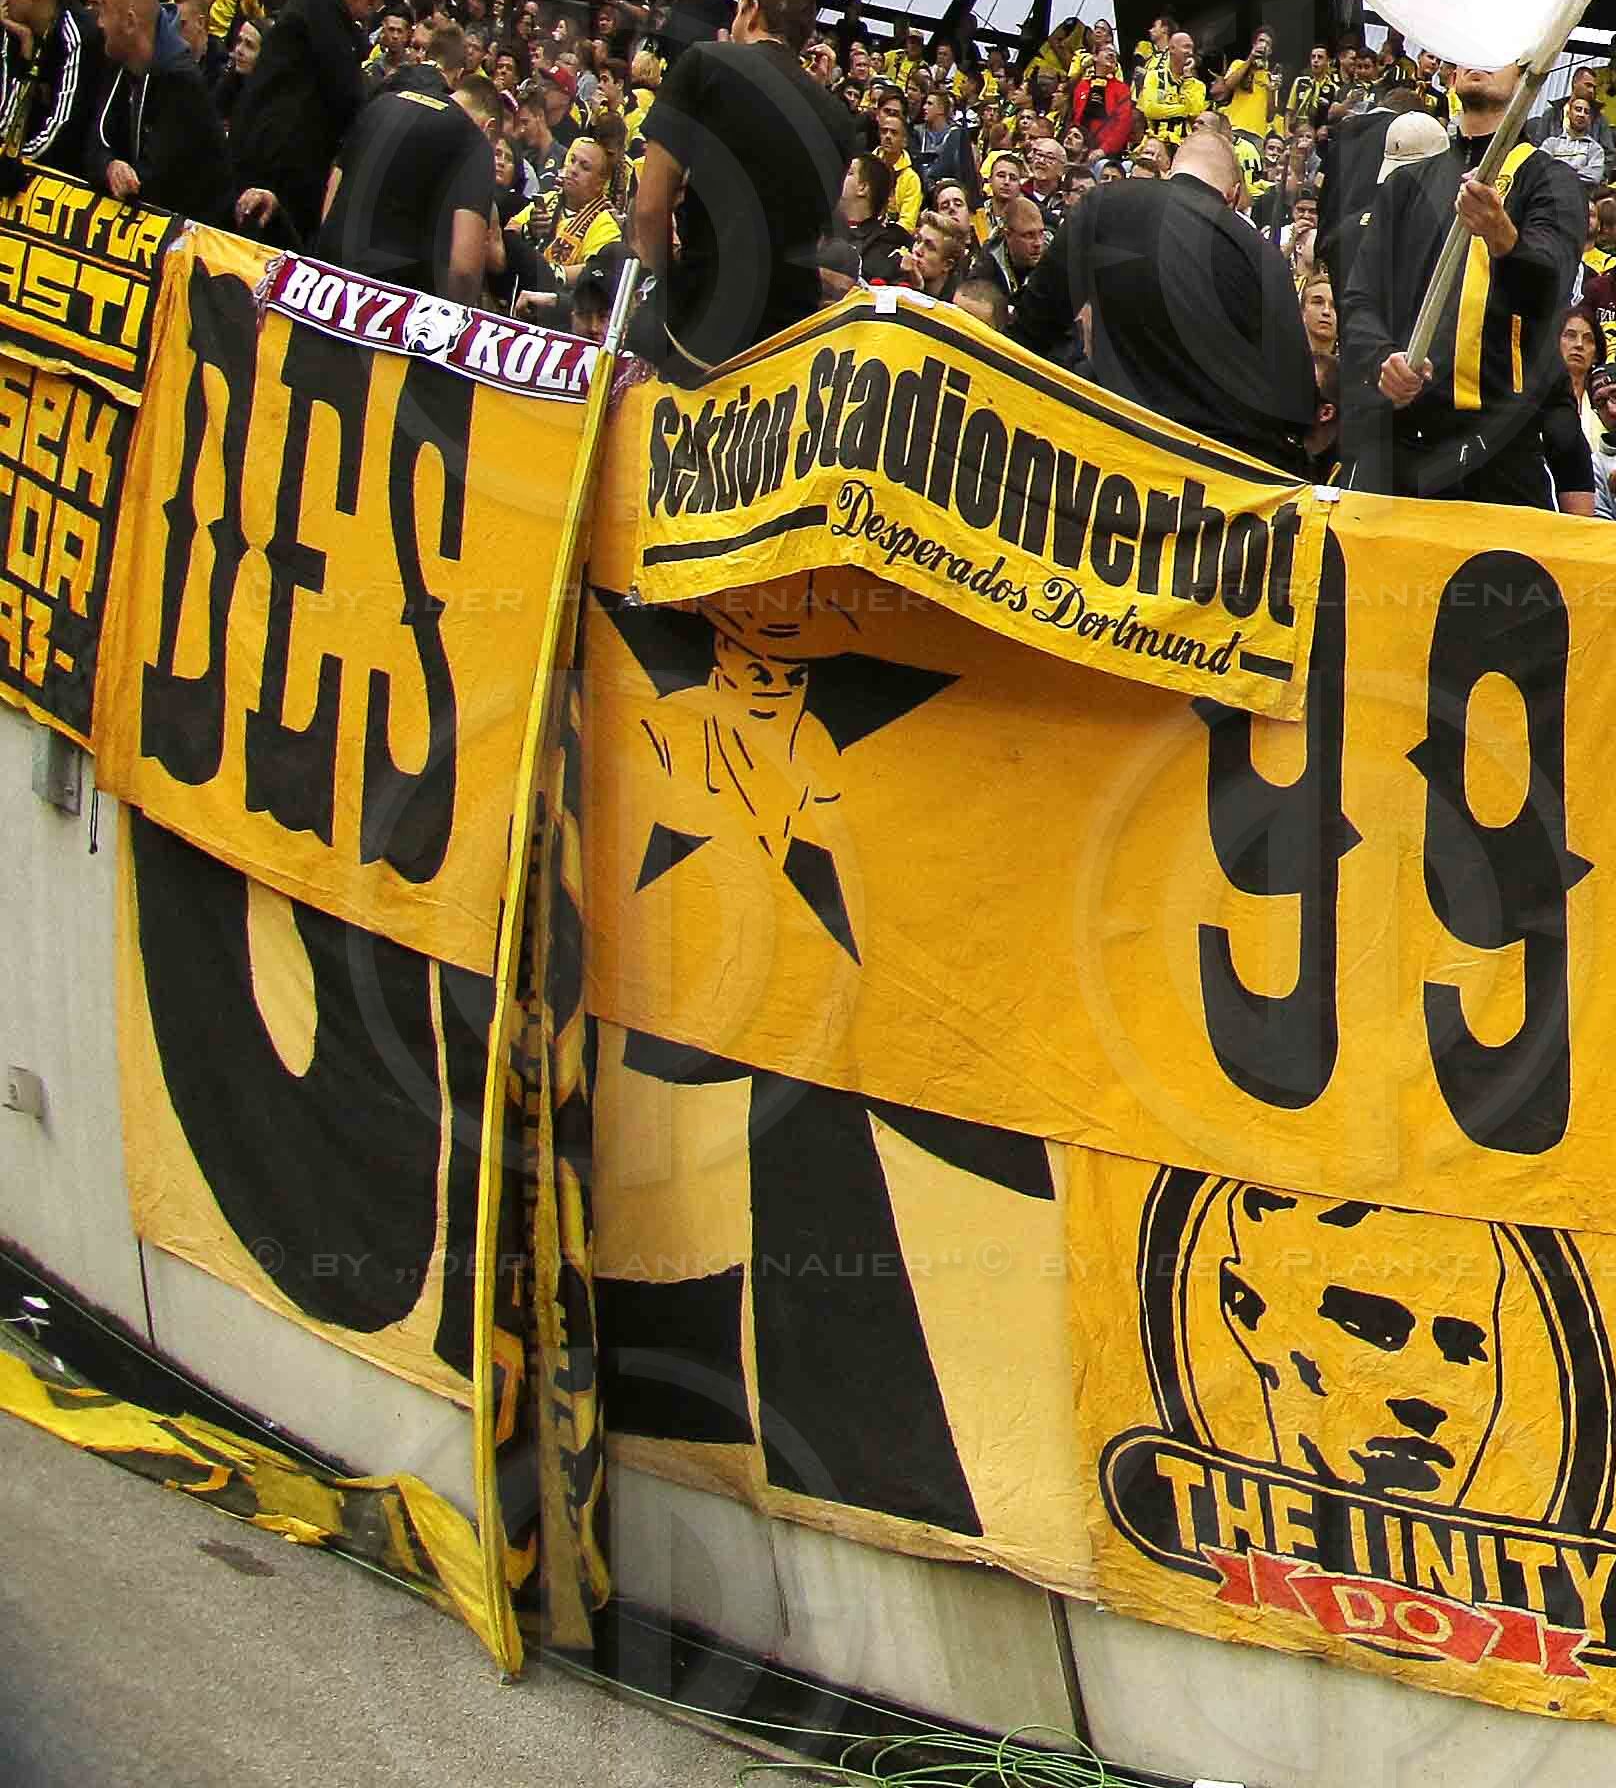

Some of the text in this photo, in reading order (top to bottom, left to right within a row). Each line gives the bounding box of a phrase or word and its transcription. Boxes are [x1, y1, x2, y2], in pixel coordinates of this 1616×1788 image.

[87, 192, 171, 270] FÜR
[280, 259, 407, 343] BOYZ
[646, 347, 1305, 628] Sektion Stadionverbot
[829, 478, 1243, 676] Desperados Dortmund
[1154, 1451, 1616, 1627] THE UNITY
[1335, 1584, 1454, 1646] DO
